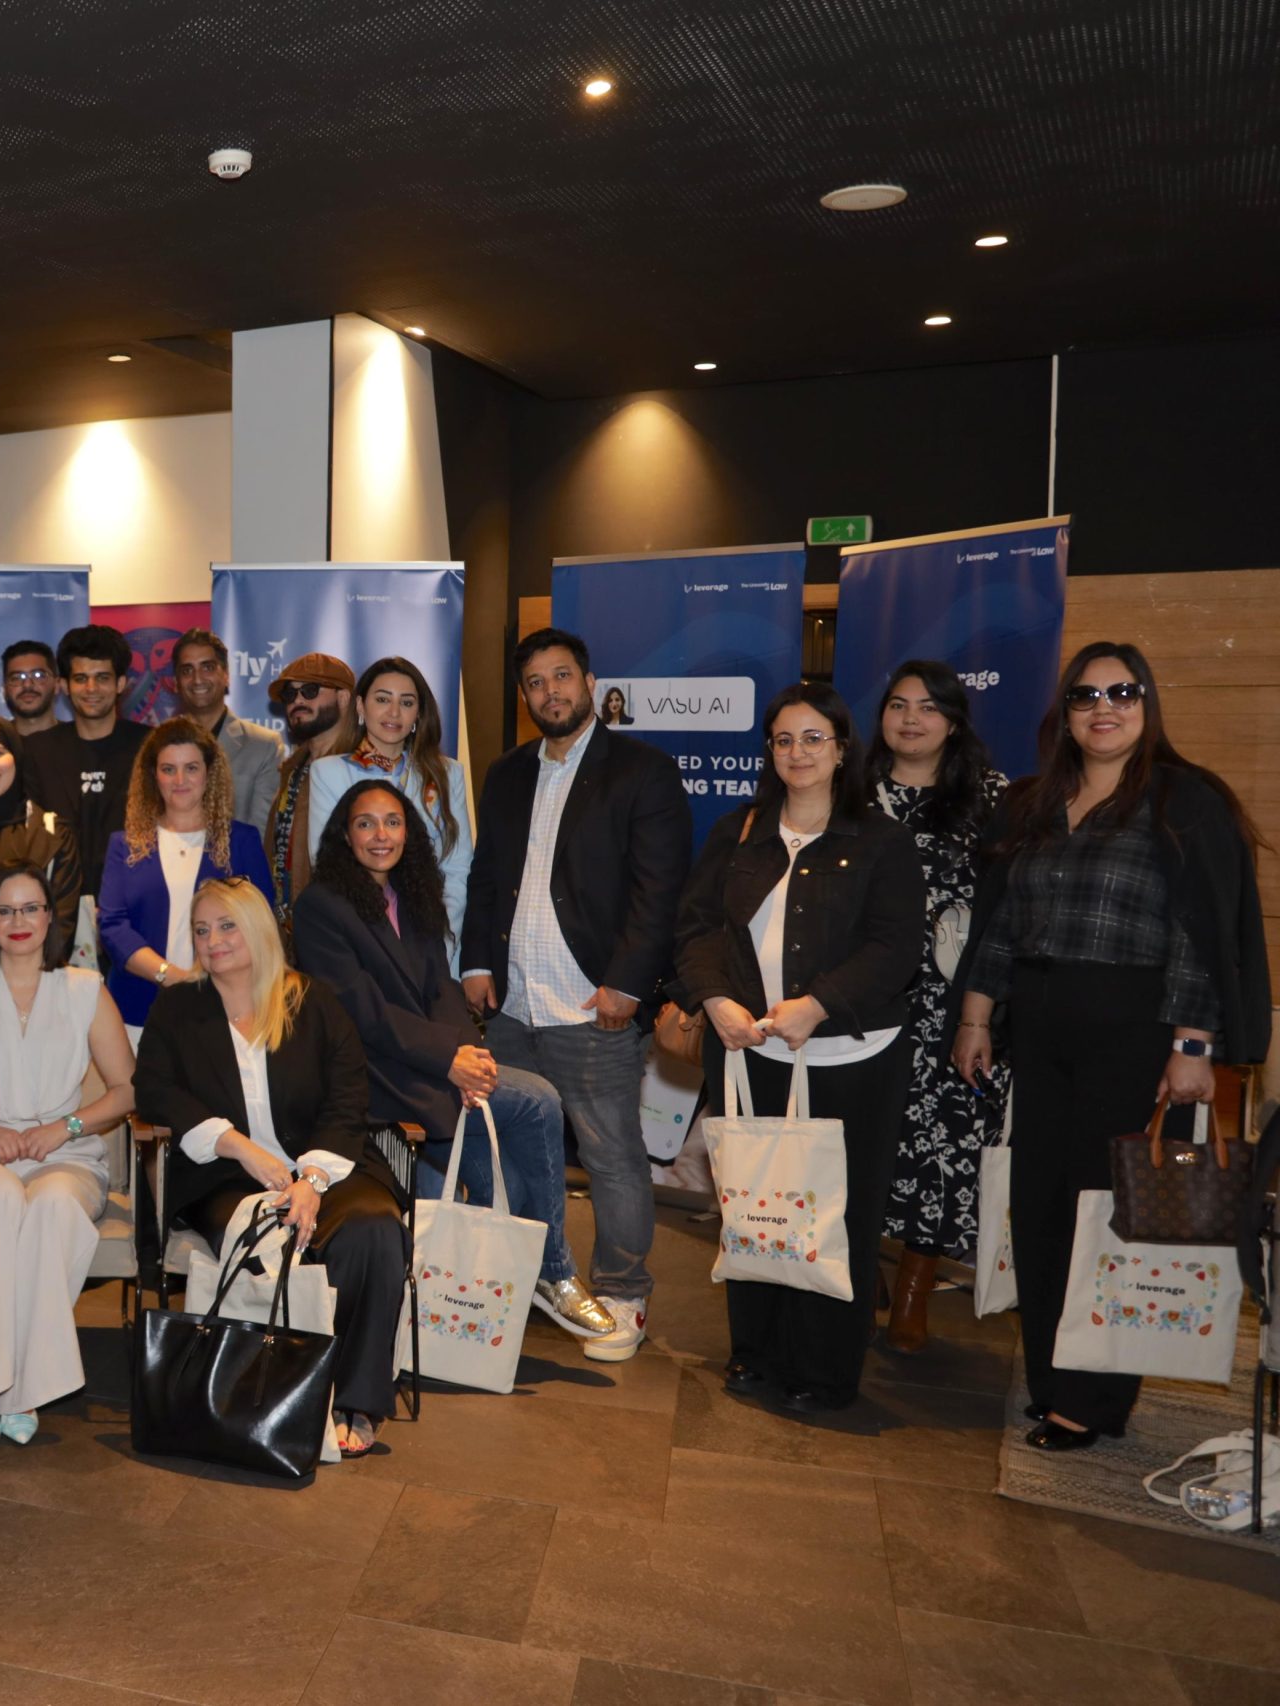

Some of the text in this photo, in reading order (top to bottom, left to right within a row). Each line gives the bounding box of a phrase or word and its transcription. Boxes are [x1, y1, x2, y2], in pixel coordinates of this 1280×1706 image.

[966, 552, 999, 562] leverage
[694, 584, 729, 592] leverage
[234, 651, 268, 685] fly
[957, 669, 1000, 691] rage
[647, 697, 730, 714] VASU AI
[713, 780, 758, 796] TEA
[747, 1213, 788, 1225] leverage
[1136, 1282, 1186, 1296] leverage
[444, 1293, 485, 1310] leverage
